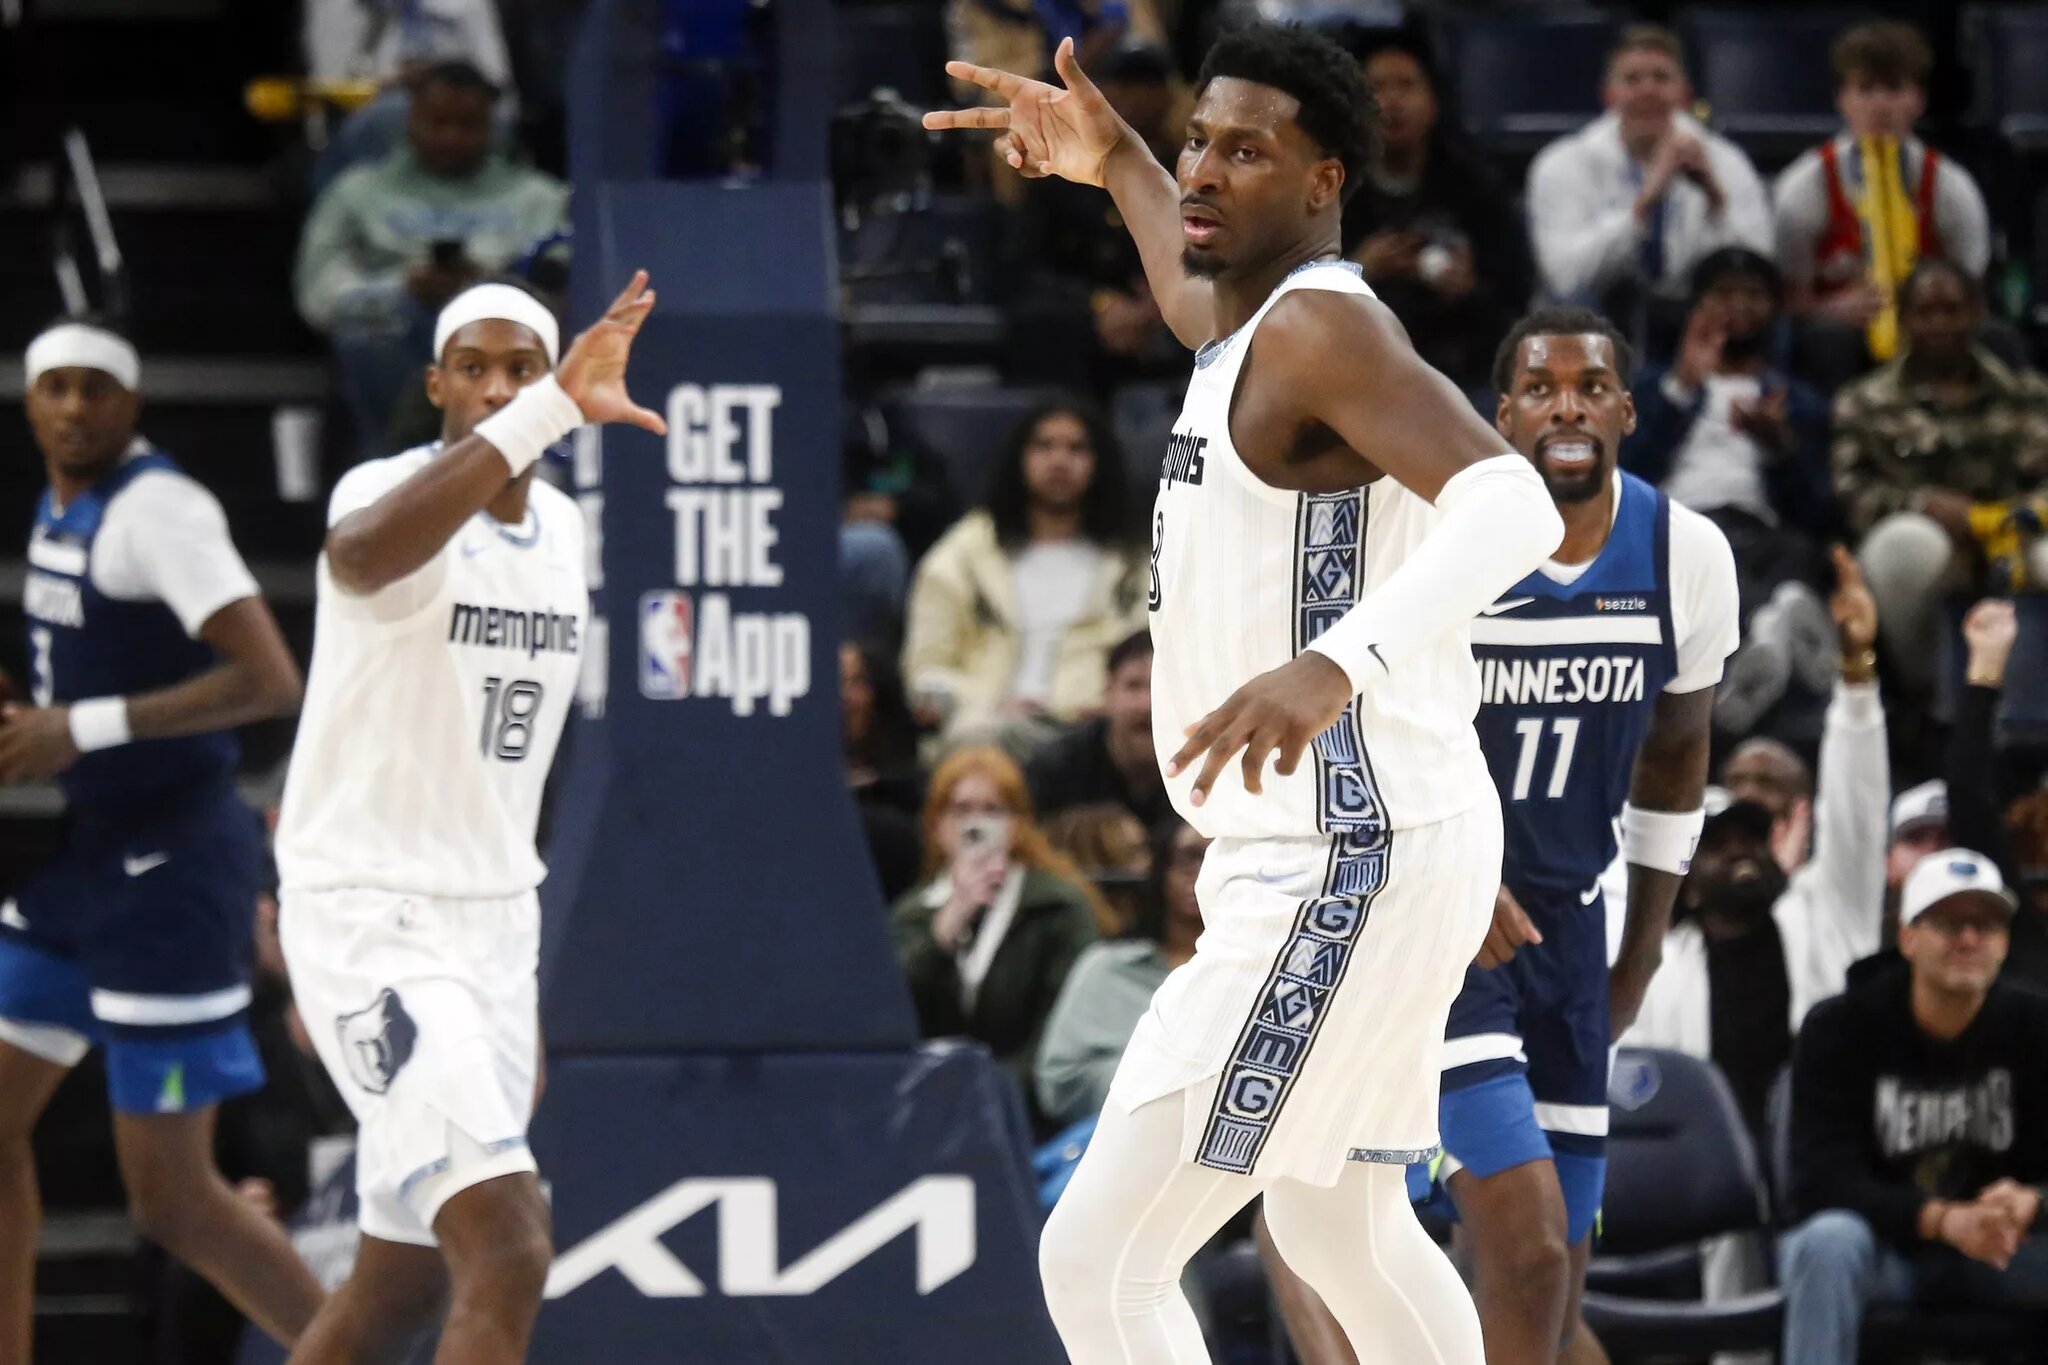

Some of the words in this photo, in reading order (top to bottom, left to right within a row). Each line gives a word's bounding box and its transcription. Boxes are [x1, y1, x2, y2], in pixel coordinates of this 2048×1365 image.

[667, 383, 781, 483] GET
[664, 487, 784, 587] THE
[449, 603, 577, 660] memphis
[1604, 597, 1647, 610] sezzle
[694, 592, 811, 717] App
[1477, 656, 1644, 704] INNESOTA
[480, 677, 543, 761] 18
[1512, 717, 1581, 800] 11
